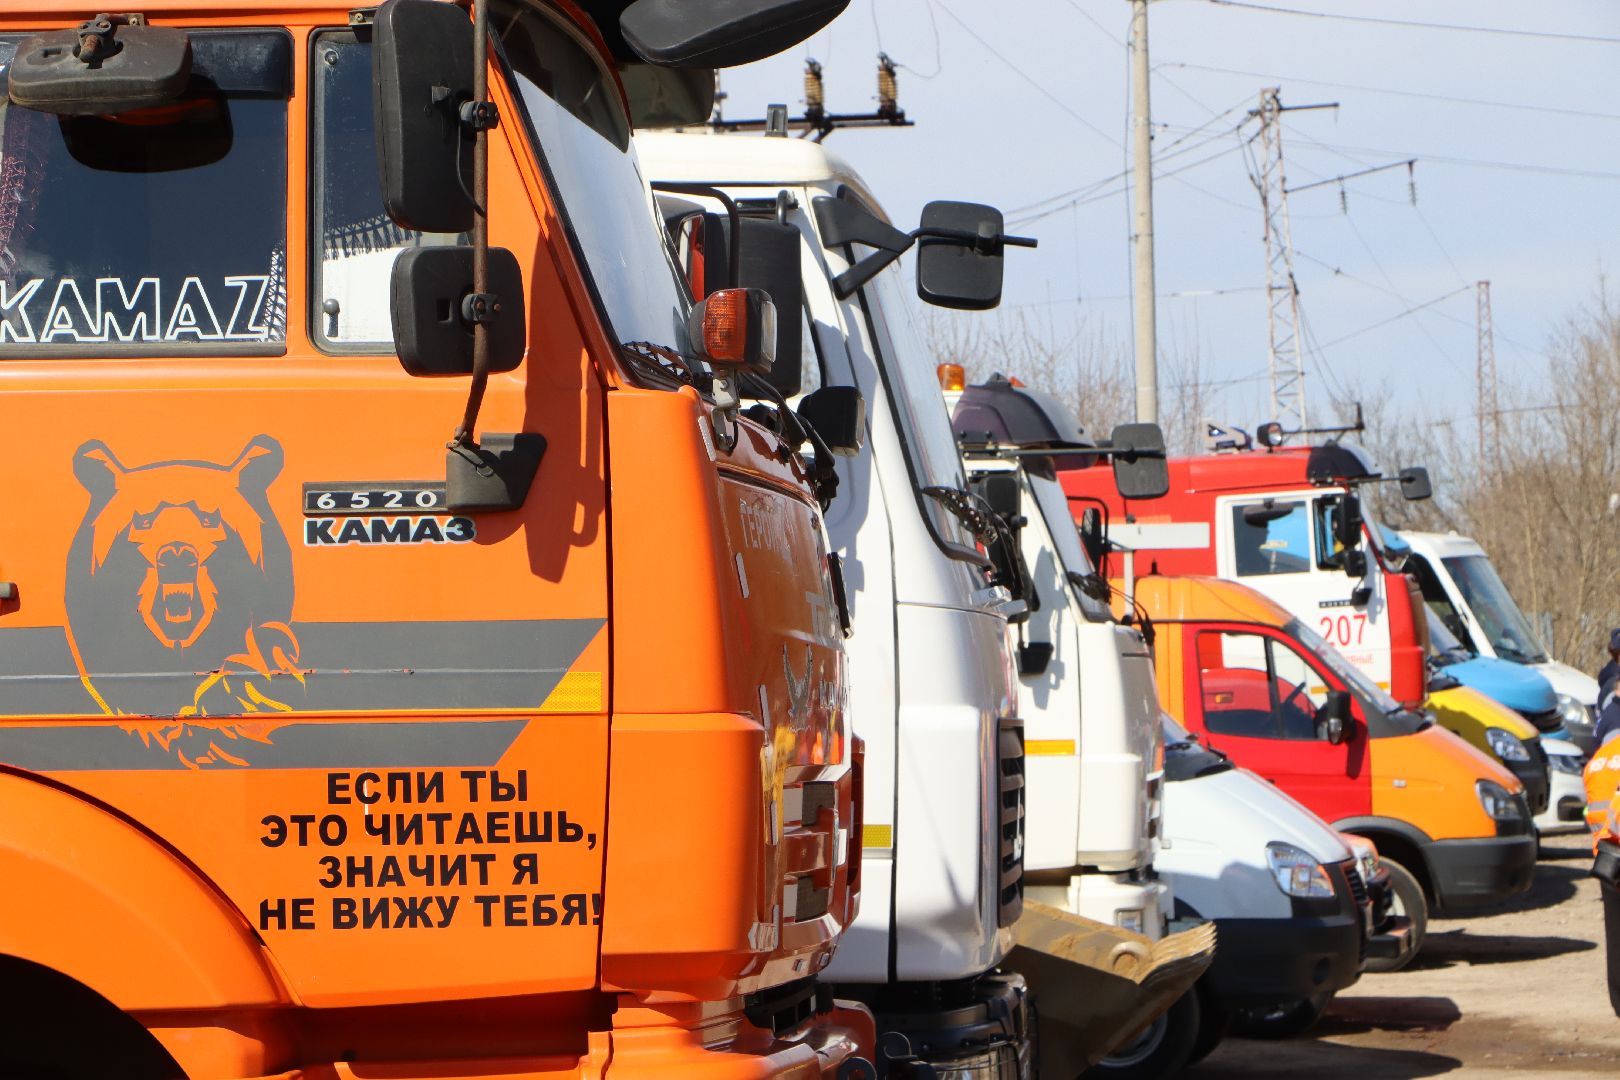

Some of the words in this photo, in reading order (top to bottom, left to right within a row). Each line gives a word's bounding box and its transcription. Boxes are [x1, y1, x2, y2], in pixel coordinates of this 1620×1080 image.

[0, 276, 270, 343] KAMAZ
[317, 491, 437, 510] 6520
[306, 517, 475, 544] КАМАЗ
[1320, 614, 1367, 647] 207
[460, 770, 528, 802] ТЫ
[260, 814, 348, 848] ЭТО
[364, 810, 597, 851] ЧИТАЕШЬ,
[318, 853, 496, 889] ЗНАЧИТ
[512, 853, 539, 885] Я
[259, 898, 316, 930] НЕ
[332, 895, 460, 930] ВИЖУ
[474, 893, 600, 927] ТЕБЯ!
